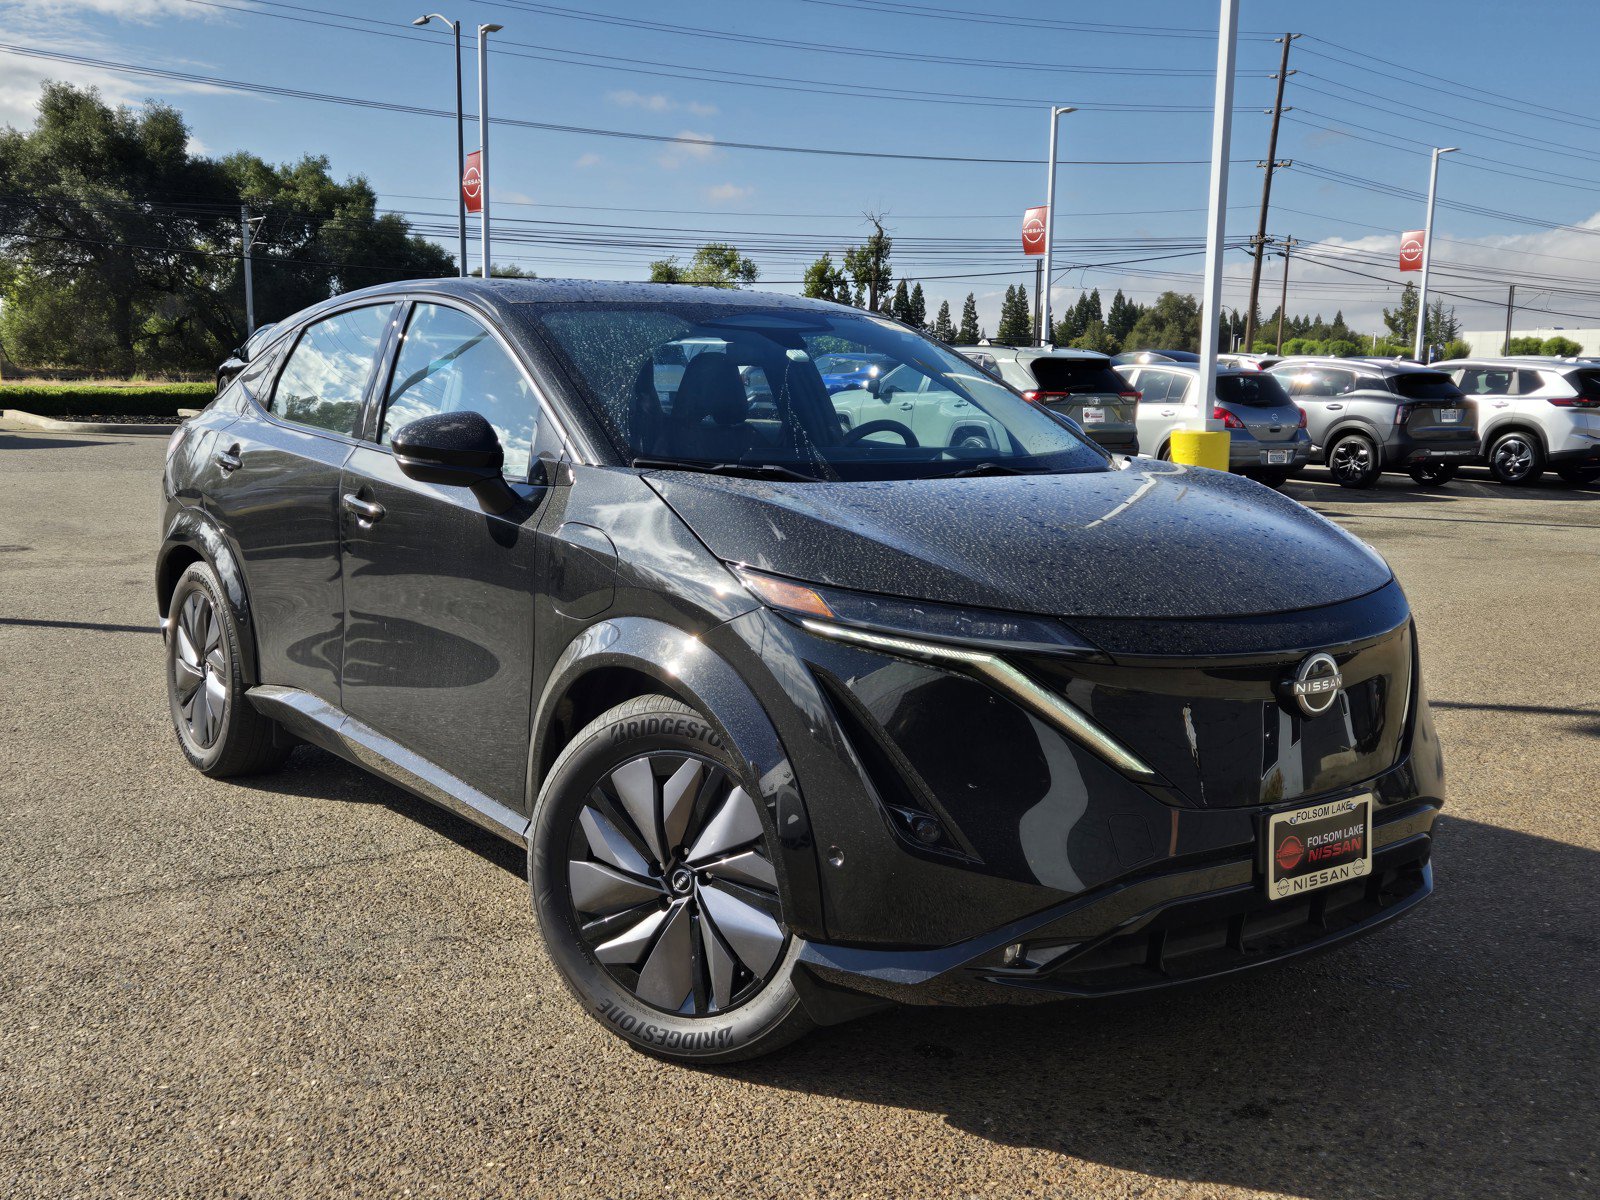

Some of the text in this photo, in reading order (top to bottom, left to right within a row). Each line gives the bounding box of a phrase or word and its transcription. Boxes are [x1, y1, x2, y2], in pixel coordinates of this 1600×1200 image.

[1296, 677, 1342, 693] NISSAN
[611, 718, 724, 751] BRIDGESTO
[1296, 801, 1351, 821] FOLSOM LAKE
[1307, 824, 1364, 848] FOLSOM LAKE
[1308, 837, 1362, 863] NISSAN
[1293, 866, 1349, 891] NISSAN
[596, 998, 734, 1051] BRIDGESTONE
